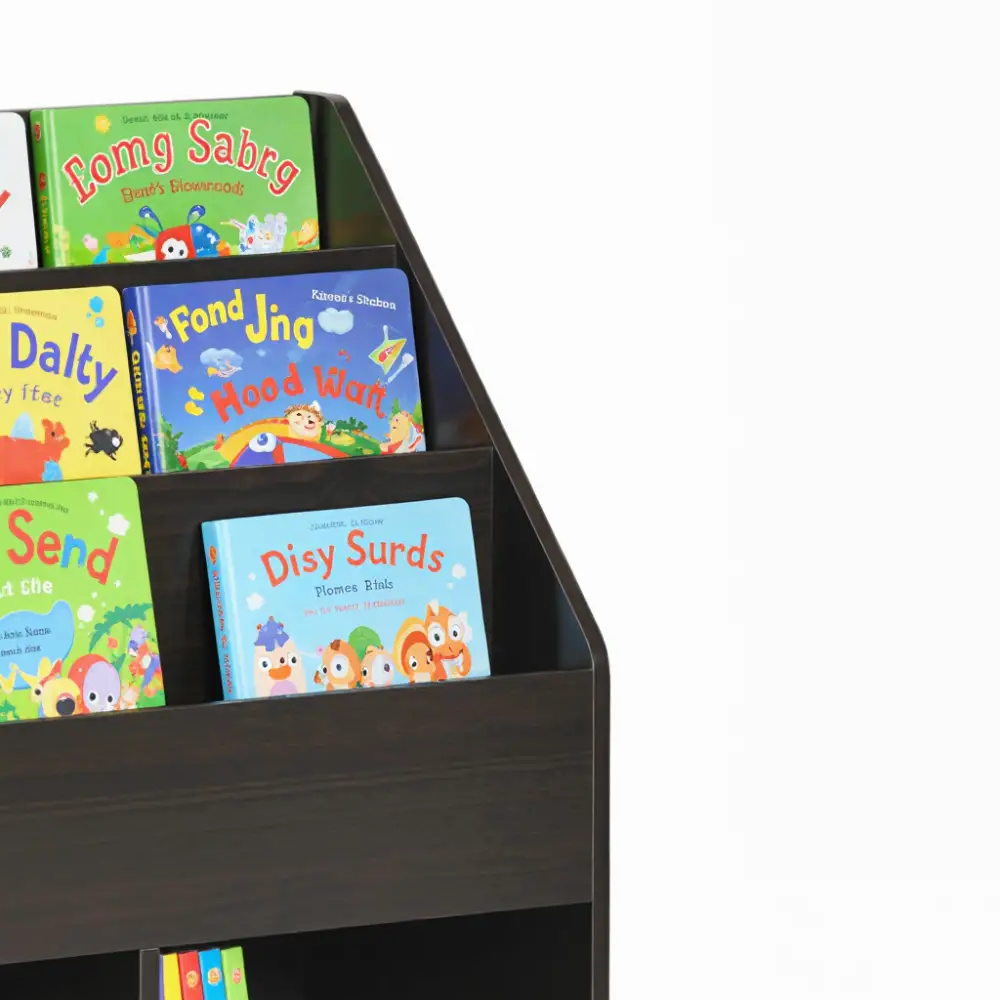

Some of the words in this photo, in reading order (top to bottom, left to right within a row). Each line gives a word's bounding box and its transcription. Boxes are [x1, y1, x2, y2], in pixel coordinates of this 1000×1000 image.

[187, 117, 302, 196] Sabrg
[168, 288, 245, 344] Fond
[10, 321, 119, 404] Dalty
[209, 361, 305, 424] Hood
[6, 508, 120, 586] Send
[260, 543, 336, 588] Disy
[346, 528, 446, 573] Surds
